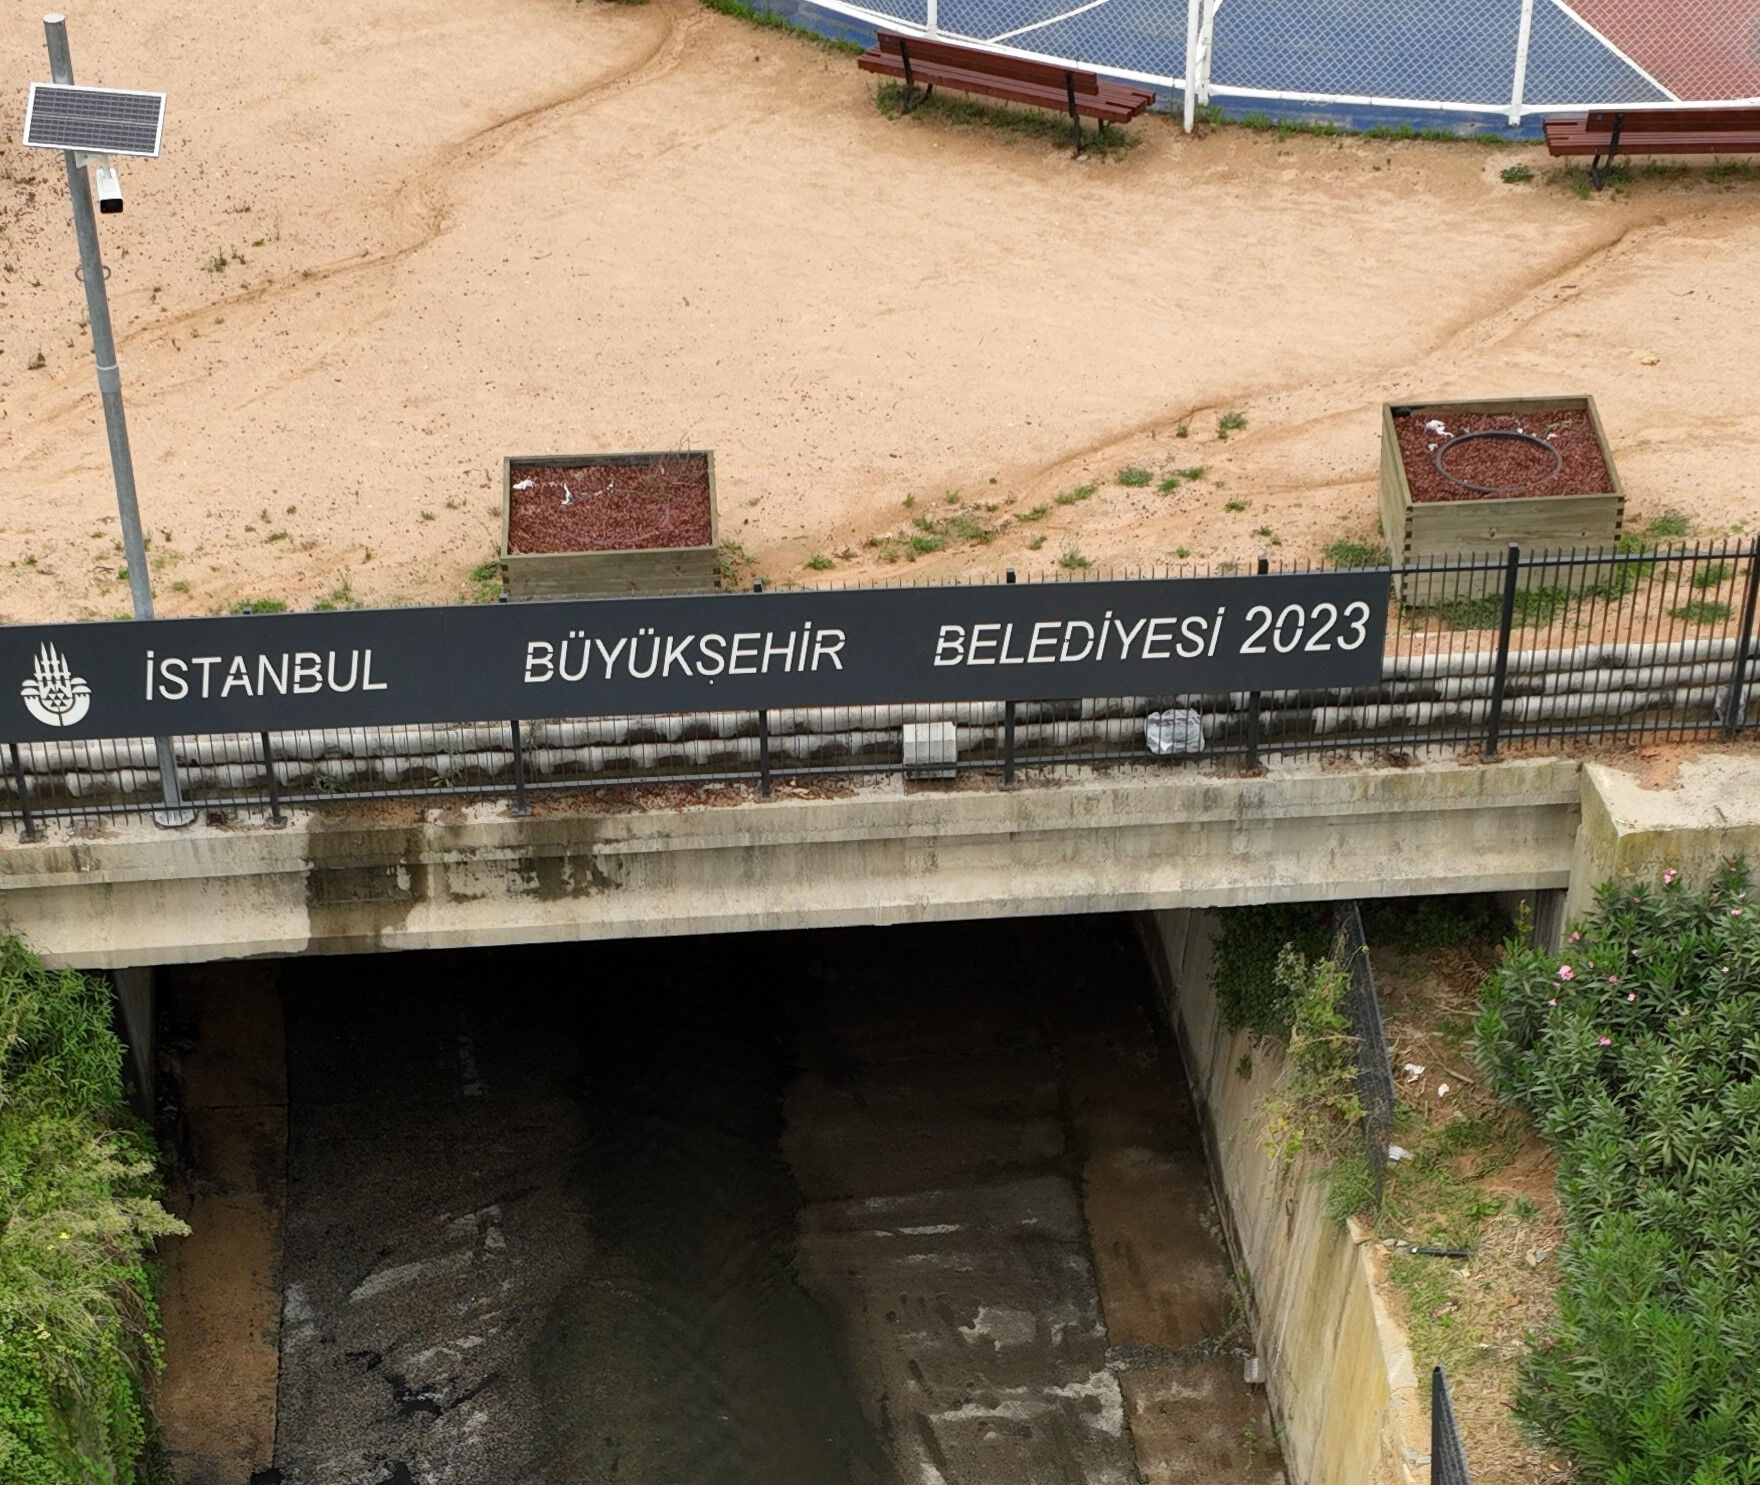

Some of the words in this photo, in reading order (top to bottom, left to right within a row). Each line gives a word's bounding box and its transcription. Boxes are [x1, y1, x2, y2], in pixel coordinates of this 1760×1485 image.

[146, 650, 388, 701] İSTANBUL
[933, 606, 1226, 666] BELEDİYESİ
[1239, 601, 1370, 654] 2023
